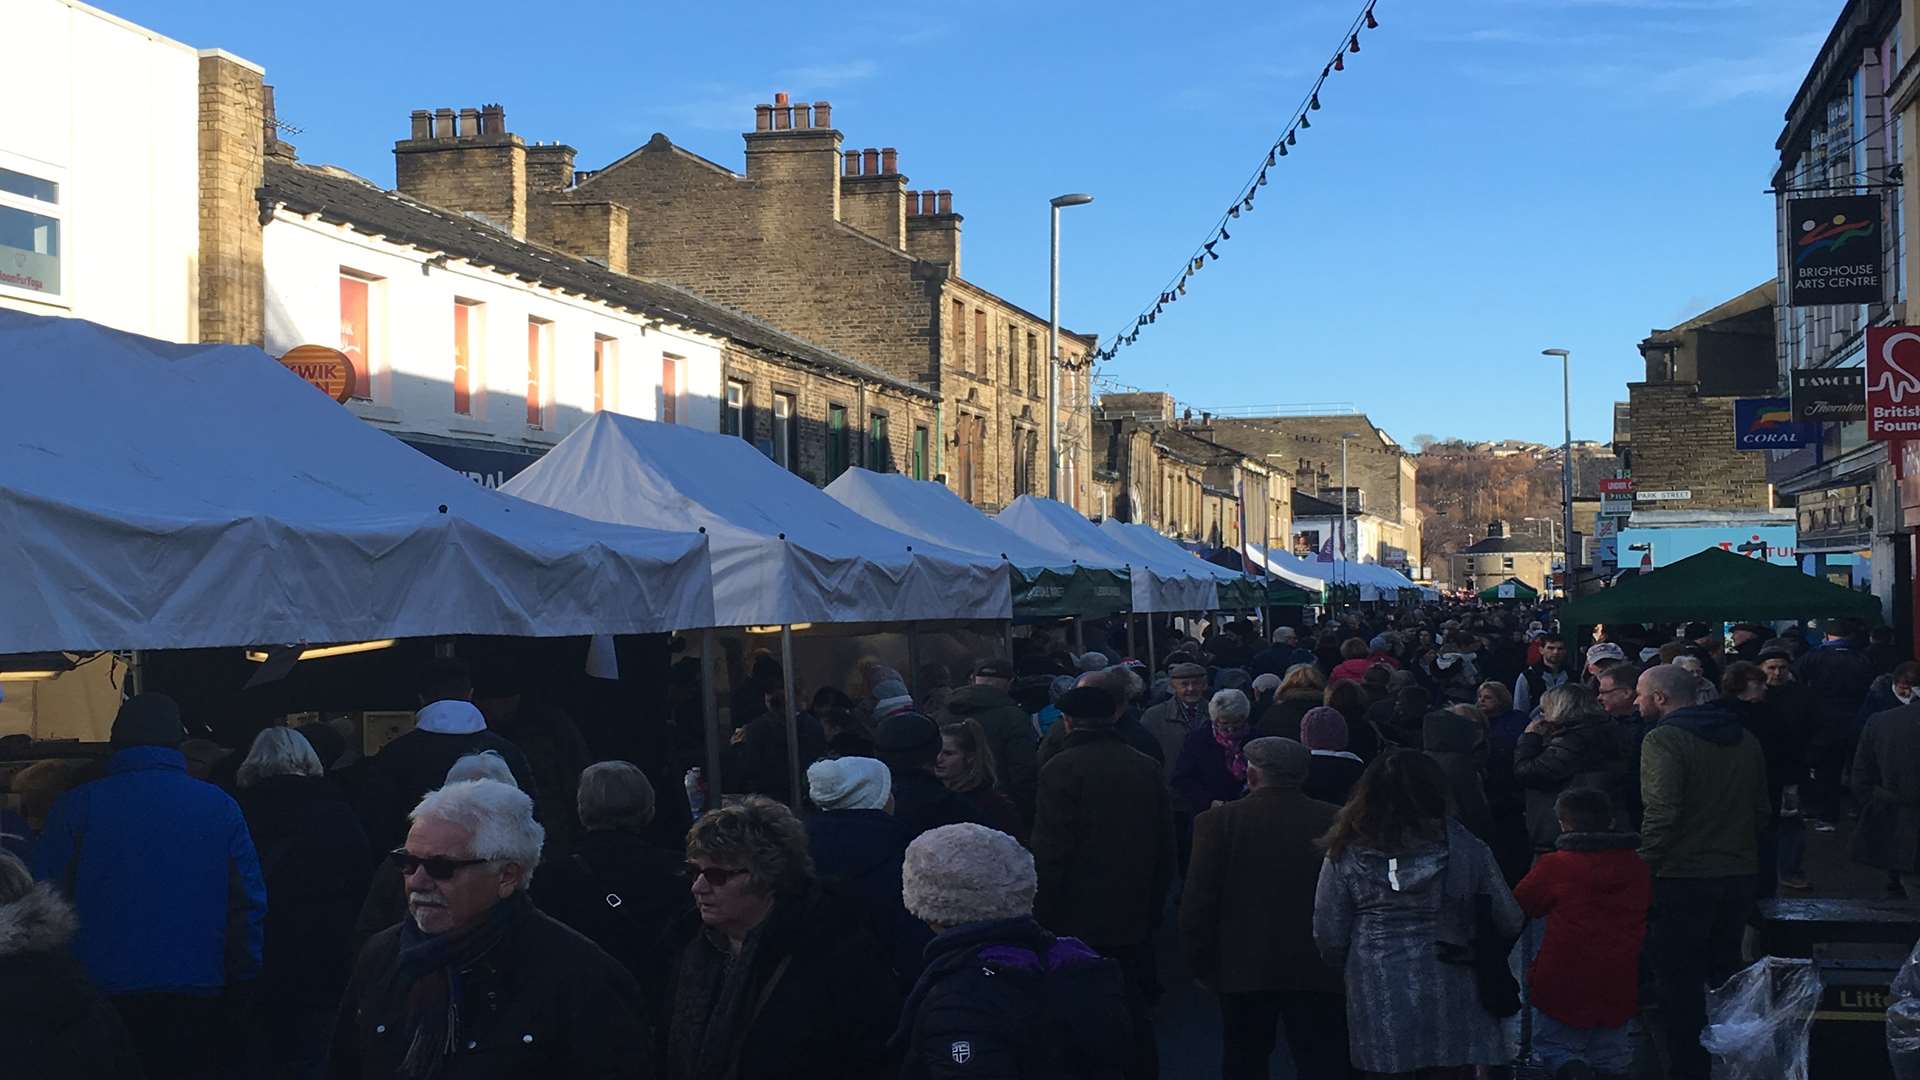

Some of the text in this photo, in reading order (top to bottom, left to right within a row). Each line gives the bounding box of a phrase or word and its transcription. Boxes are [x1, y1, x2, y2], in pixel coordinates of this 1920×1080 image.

[1799, 264, 1874, 278] BRIGHOUSE
[1795, 276, 1880, 289] ARTS CENTRE
[1743, 433, 1798, 443] CORAL
[1661, 491, 1690, 499] STREET
